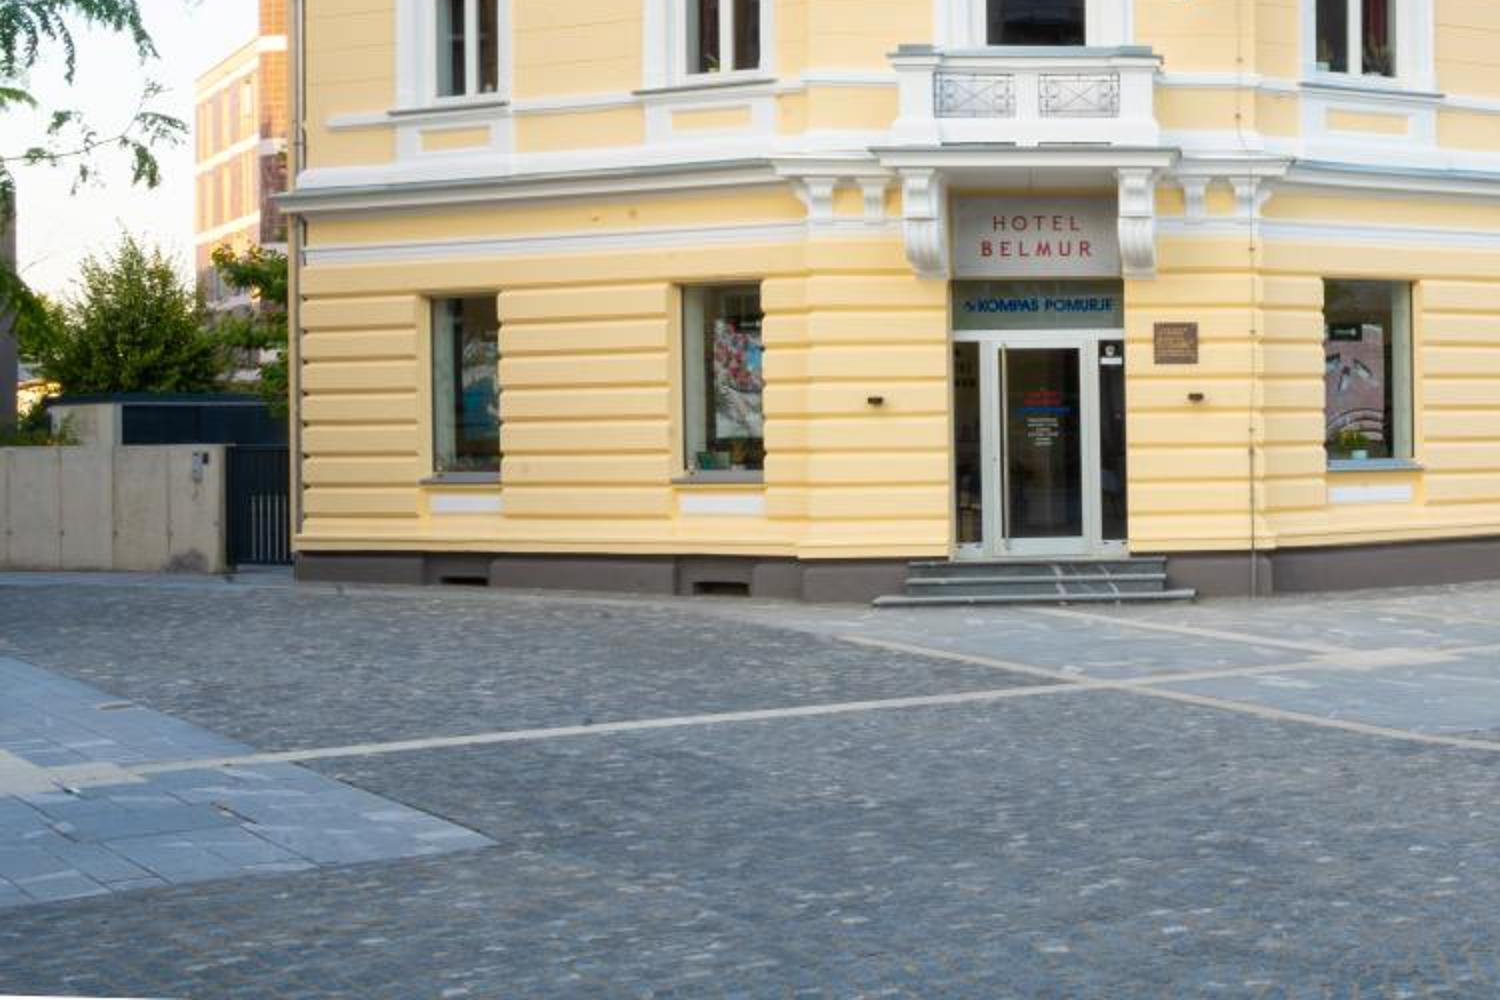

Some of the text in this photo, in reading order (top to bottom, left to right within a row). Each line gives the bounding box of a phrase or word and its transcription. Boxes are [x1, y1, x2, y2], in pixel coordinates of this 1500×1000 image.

[992, 215, 1080, 232] HOTEL
[981, 240, 1092, 257] BELMUR
[977, 296, 1113, 312] KOMPAS POMURJE
